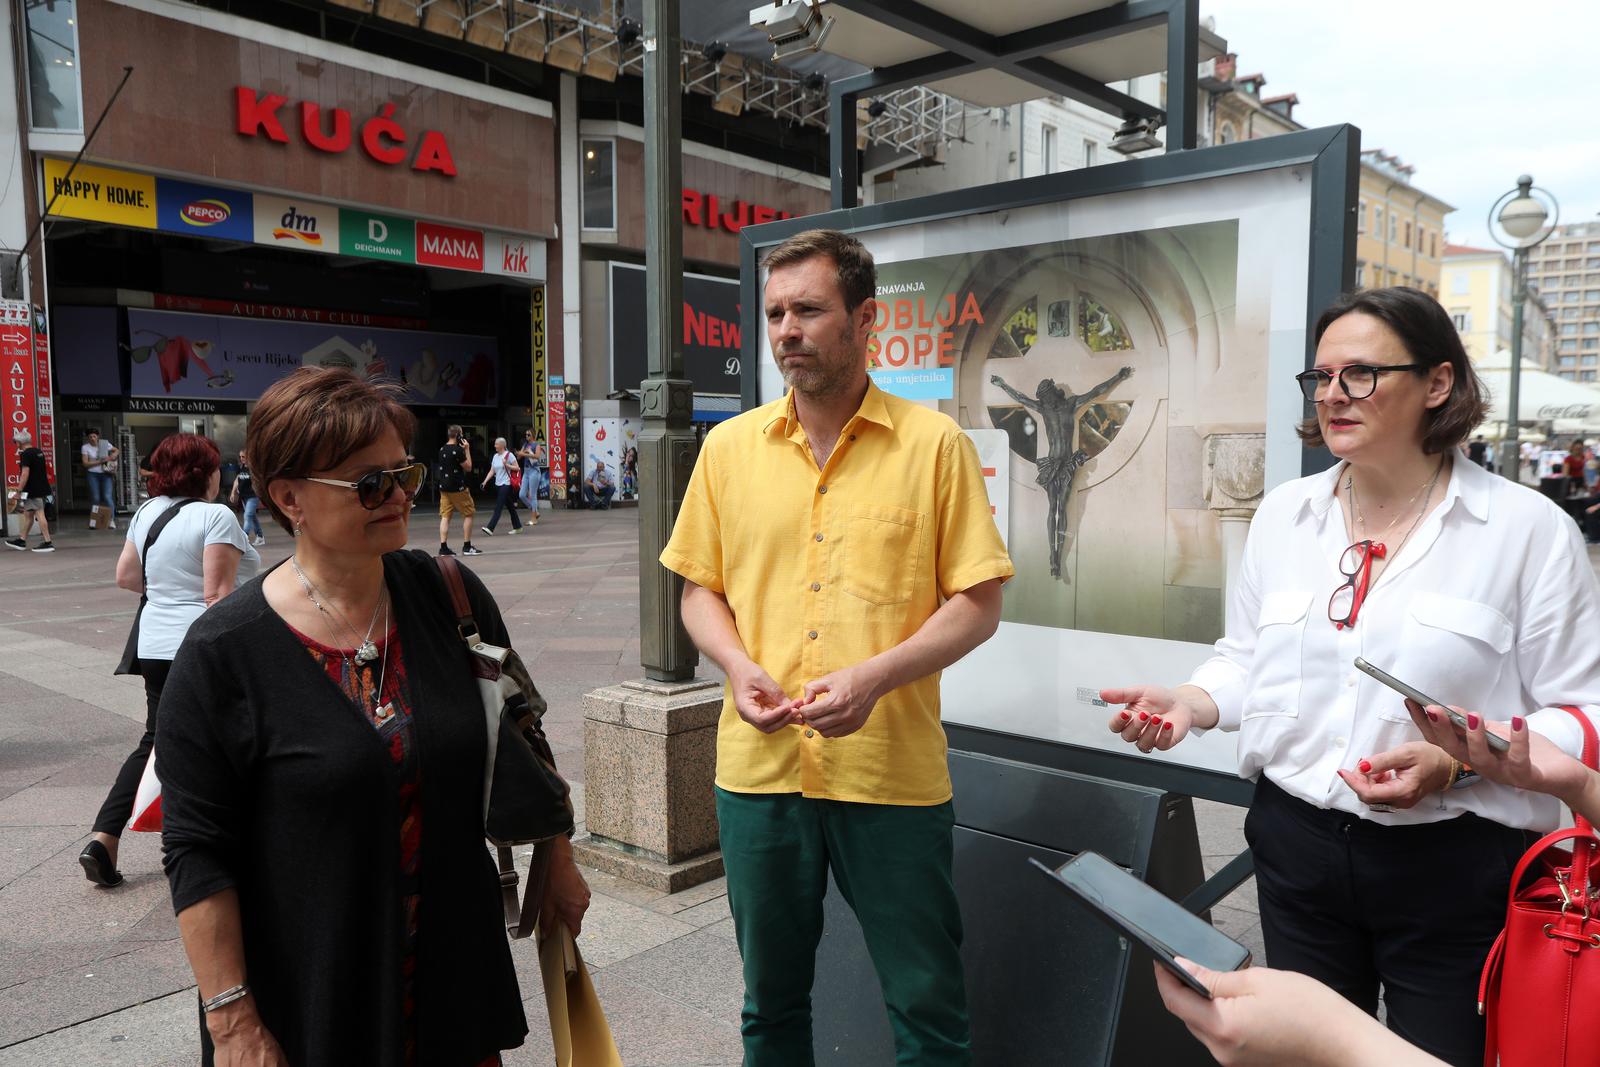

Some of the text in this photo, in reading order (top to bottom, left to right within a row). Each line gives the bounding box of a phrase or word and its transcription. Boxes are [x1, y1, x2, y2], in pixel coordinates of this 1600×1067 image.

[235, 86, 457, 177] KUĆA
[53, 176, 149, 208] HAPPY HOME.
[188, 205, 224, 220] PEPCO
[280, 206, 317, 232] dm
[682, 187, 801, 233] RIJE
[368, 219, 388, 243] D
[354, 243, 402, 256] DEICHMANN
[423, 234, 479, 260] MANA
[503, 243, 529, 273] kik
[874, 281, 926, 296] ZNAVANJA
[232, 303, 371, 325] AUTOMAT CLUB
[872, 291, 985, 333] OBLJA
[223, 351, 234, 362] U
[865, 331, 957, 369] ROPE
[533, 290, 545, 442] OTKUP ZLATA
[872, 375, 892, 385] esta
[129, 400, 215, 412] MASKICE eMDe
[553, 421, 563, 477] AUTOMA
